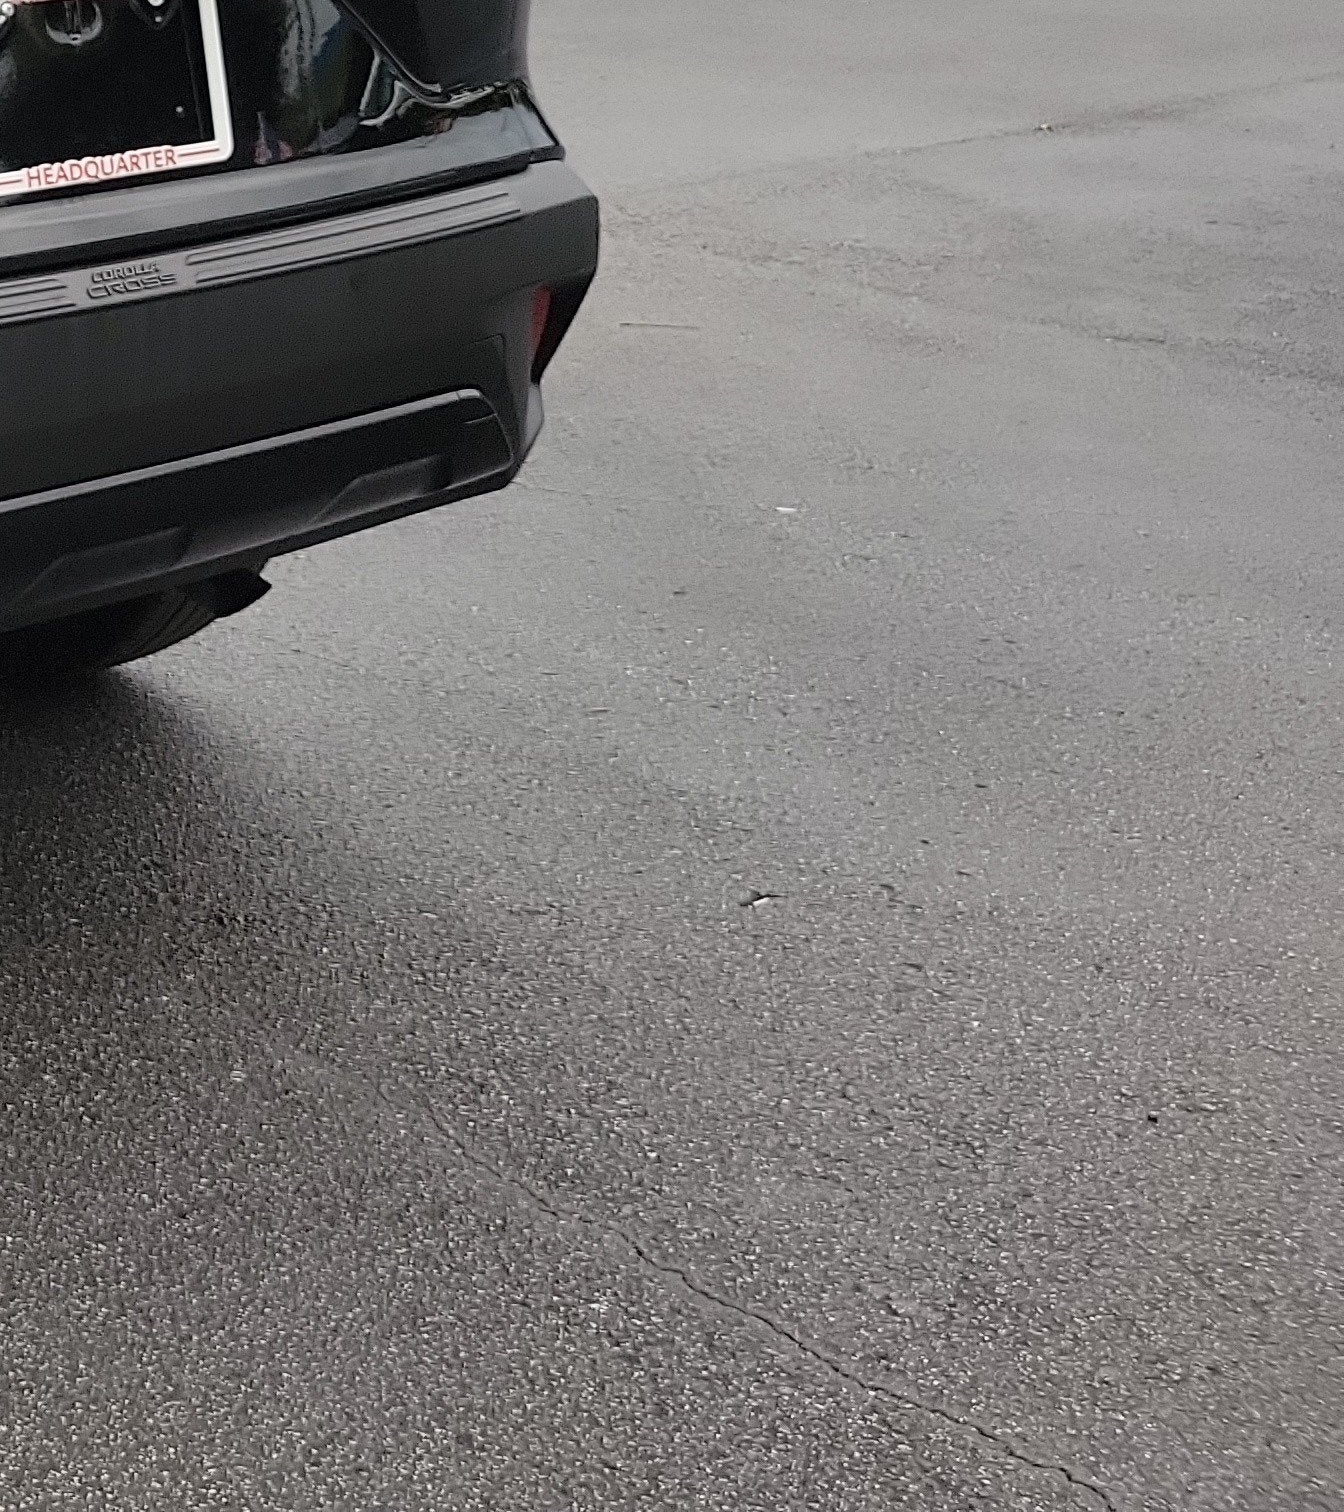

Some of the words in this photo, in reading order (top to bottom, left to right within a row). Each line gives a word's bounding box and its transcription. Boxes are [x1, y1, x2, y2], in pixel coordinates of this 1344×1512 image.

[27, 149, 177, 188] HEADQUARTER
[92, 263, 160, 282] COROLLA
[87, 273, 176, 299] CROSS
